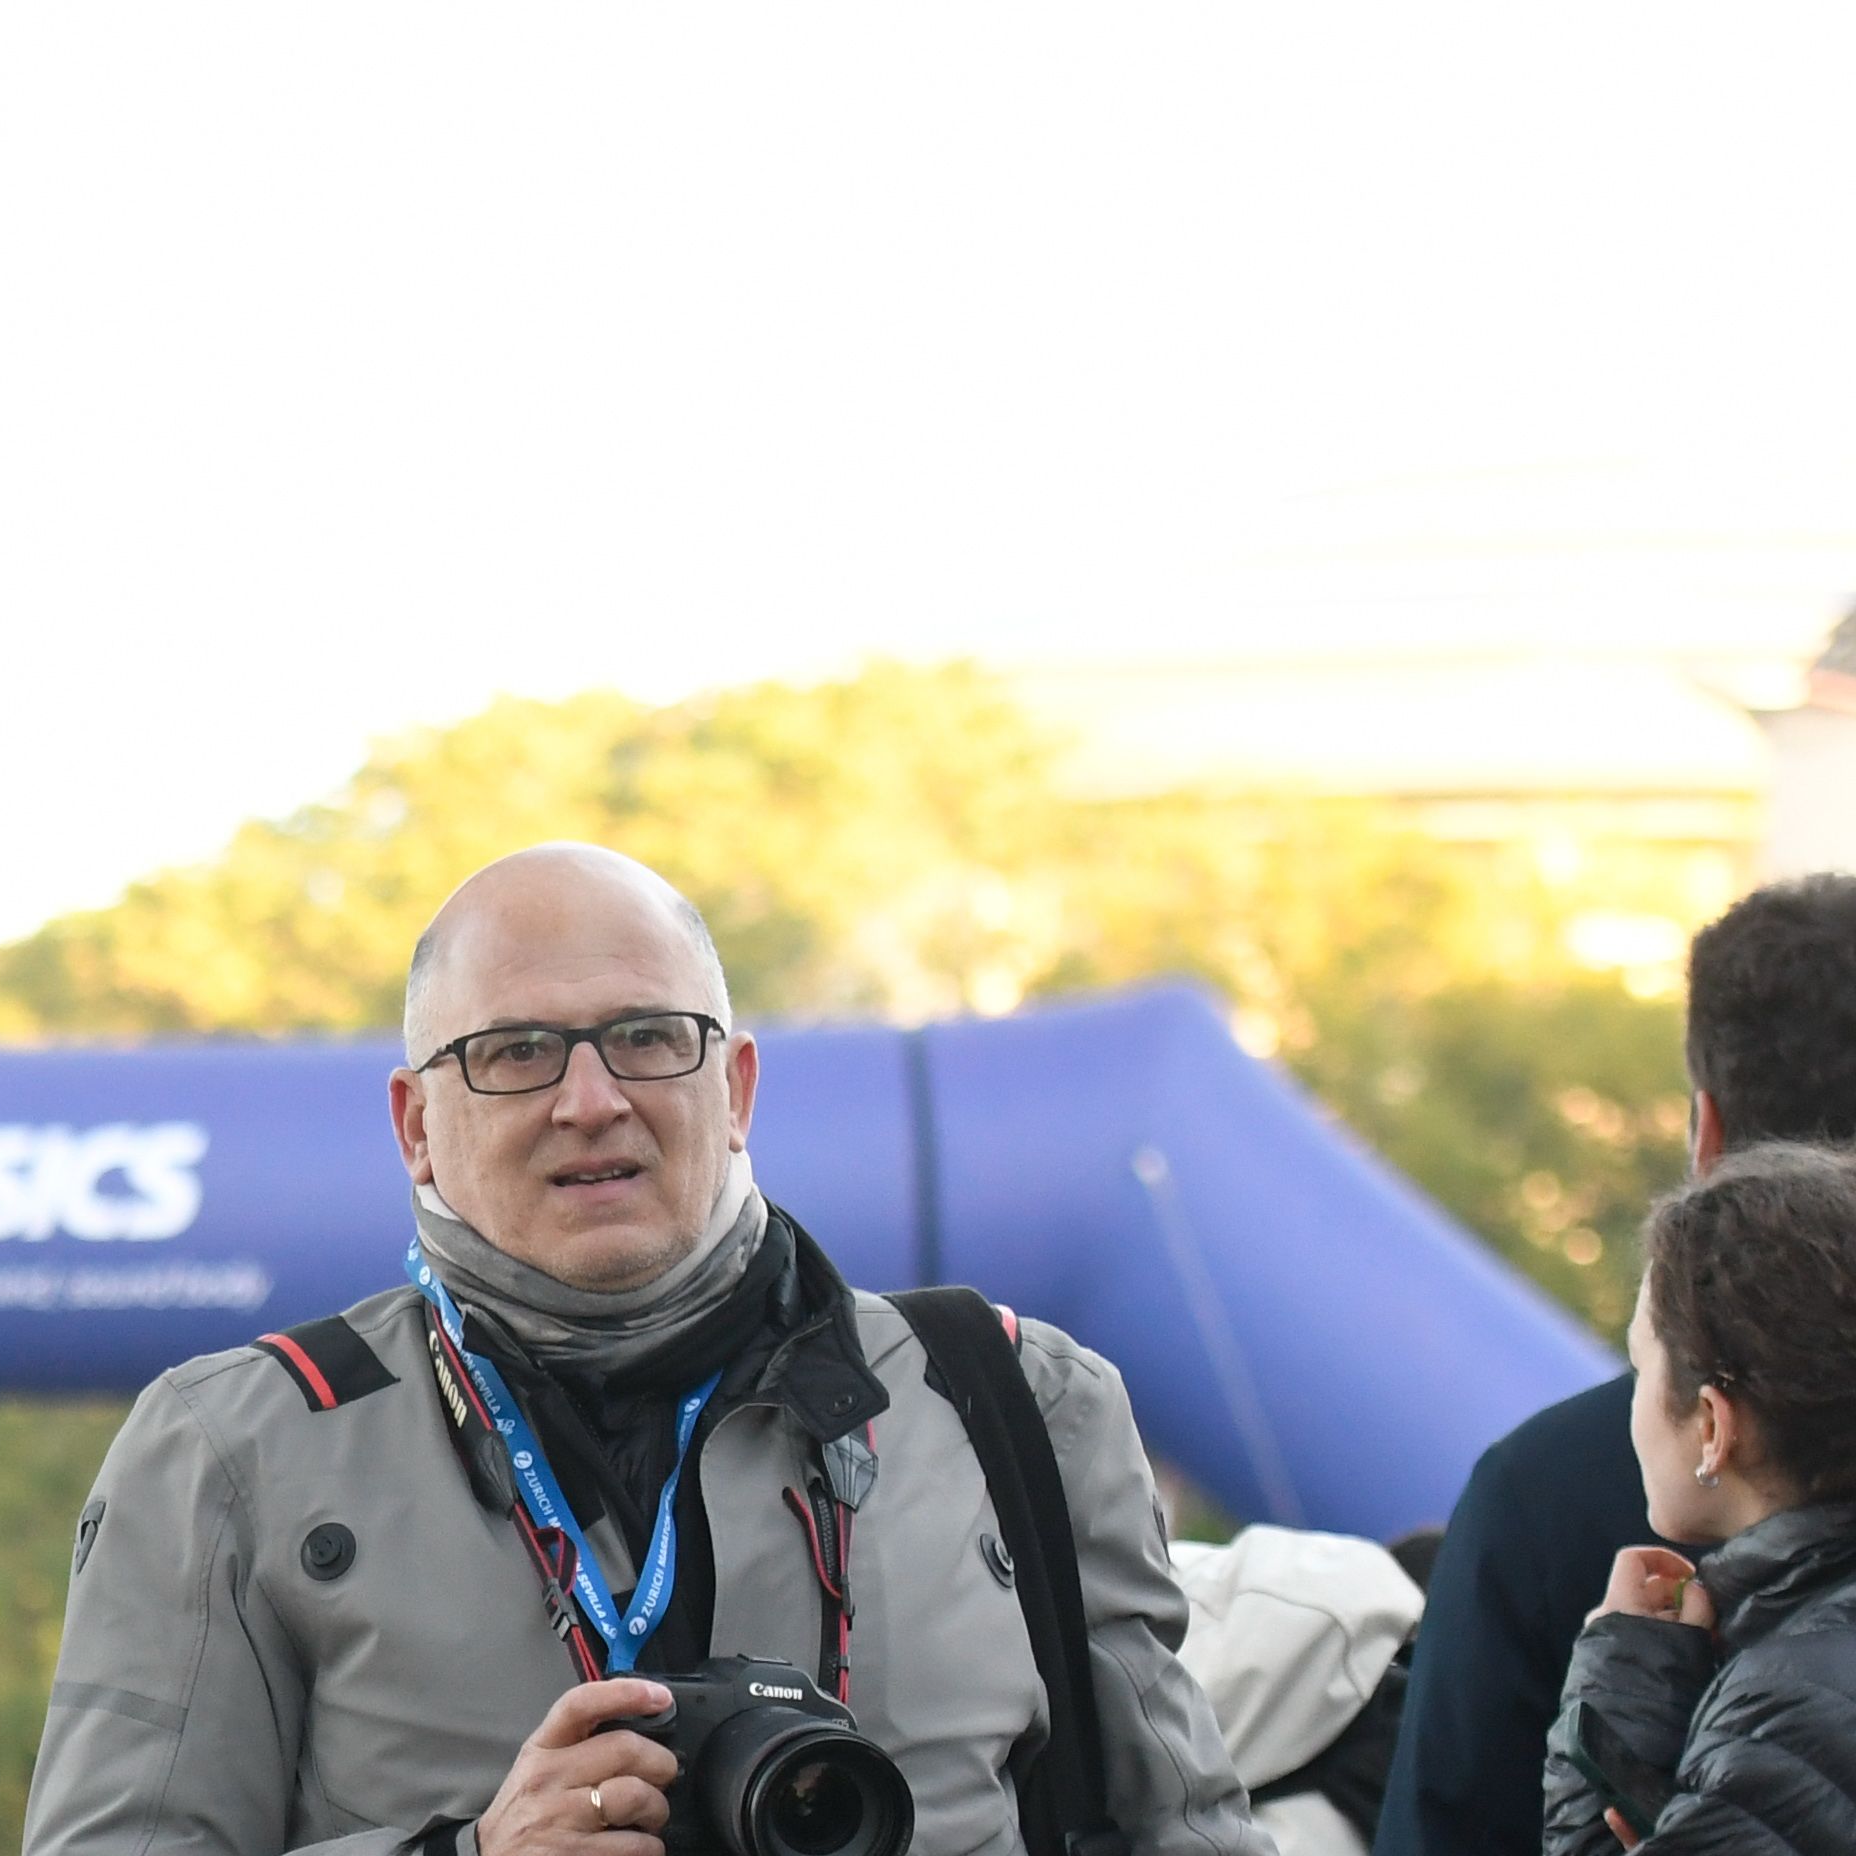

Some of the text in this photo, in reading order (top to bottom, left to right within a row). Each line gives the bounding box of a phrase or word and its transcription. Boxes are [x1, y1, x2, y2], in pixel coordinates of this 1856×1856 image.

[429, 1330, 468, 1429] Canon
[523, 1470, 554, 1516] ZURICH
[576, 1573, 607, 1619] SEVILLA
[641, 1567, 664, 1617] ZURICH
[749, 1682, 803, 1701] Canon
